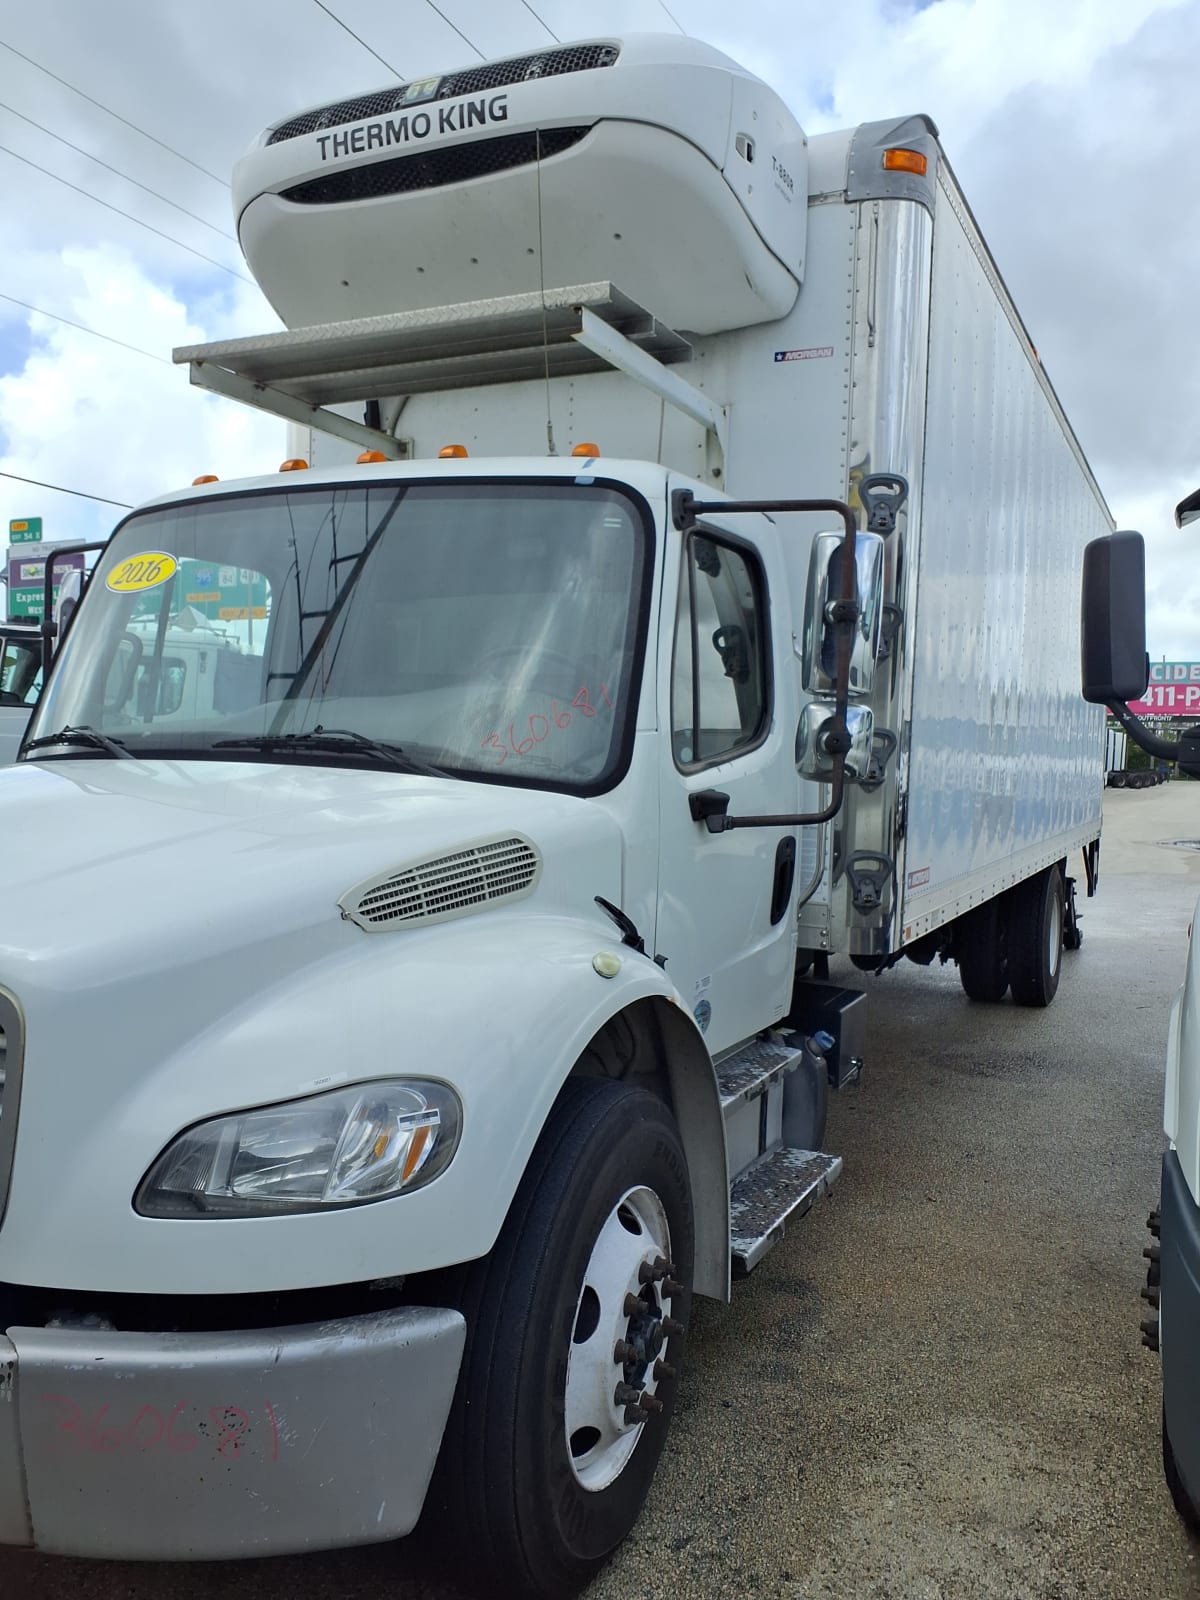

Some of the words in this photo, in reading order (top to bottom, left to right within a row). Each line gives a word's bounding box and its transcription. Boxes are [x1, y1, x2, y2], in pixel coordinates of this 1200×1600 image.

[316, 112, 432, 161] THERMO
[438, 94, 508, 134] KING
[23, 532, 33, 541] 54
[113, 558, 169, 585] 2016
[1139, 686, 1200, 707] 411-P
[480, 682, 615, 766] 360681
[40, 1393, 276, 1462] 360681
